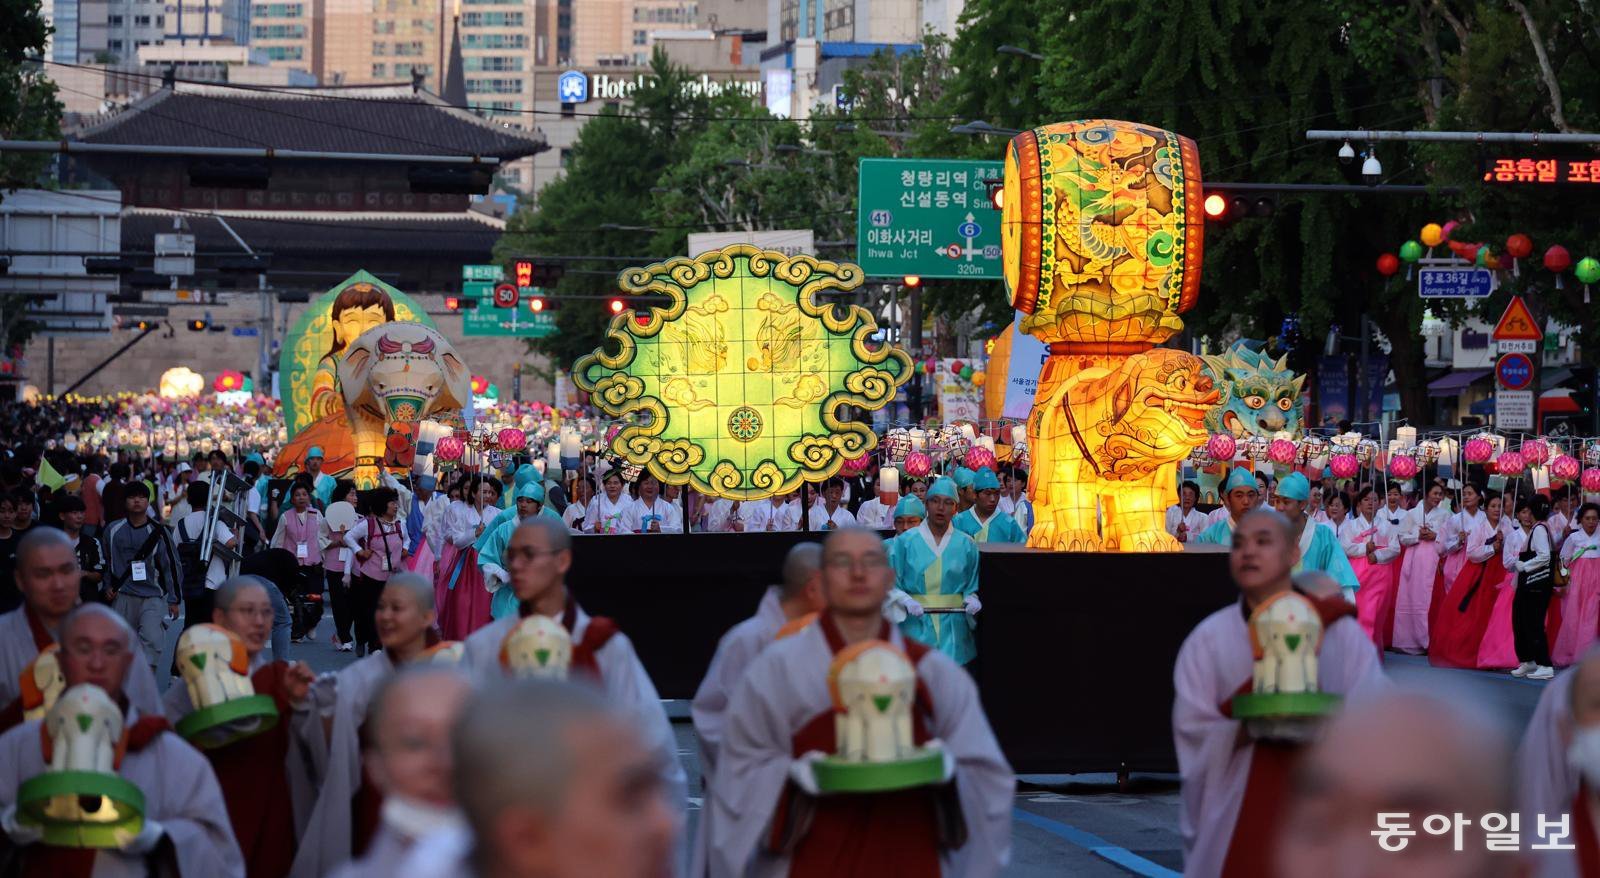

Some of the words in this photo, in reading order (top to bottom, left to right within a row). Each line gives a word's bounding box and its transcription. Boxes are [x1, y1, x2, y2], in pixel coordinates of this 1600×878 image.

[900, 169, 968, 188] 청량리역
[900, 190, 968, 209] 신설동역
[872, 213, 887, 224] 41
[965, 226, 974, 236] 6
[867, 228, 933, 246] 이화사거리
[868, 248, 893, 258] Ihwa
[900, 248, 918, 259] Jct
[984, 246, 999, 257] 50
[957, 264, 984, 275] 320m
[1423, 272, 1468, 285] 종로36길
[500, 290, 513, 301] 50
